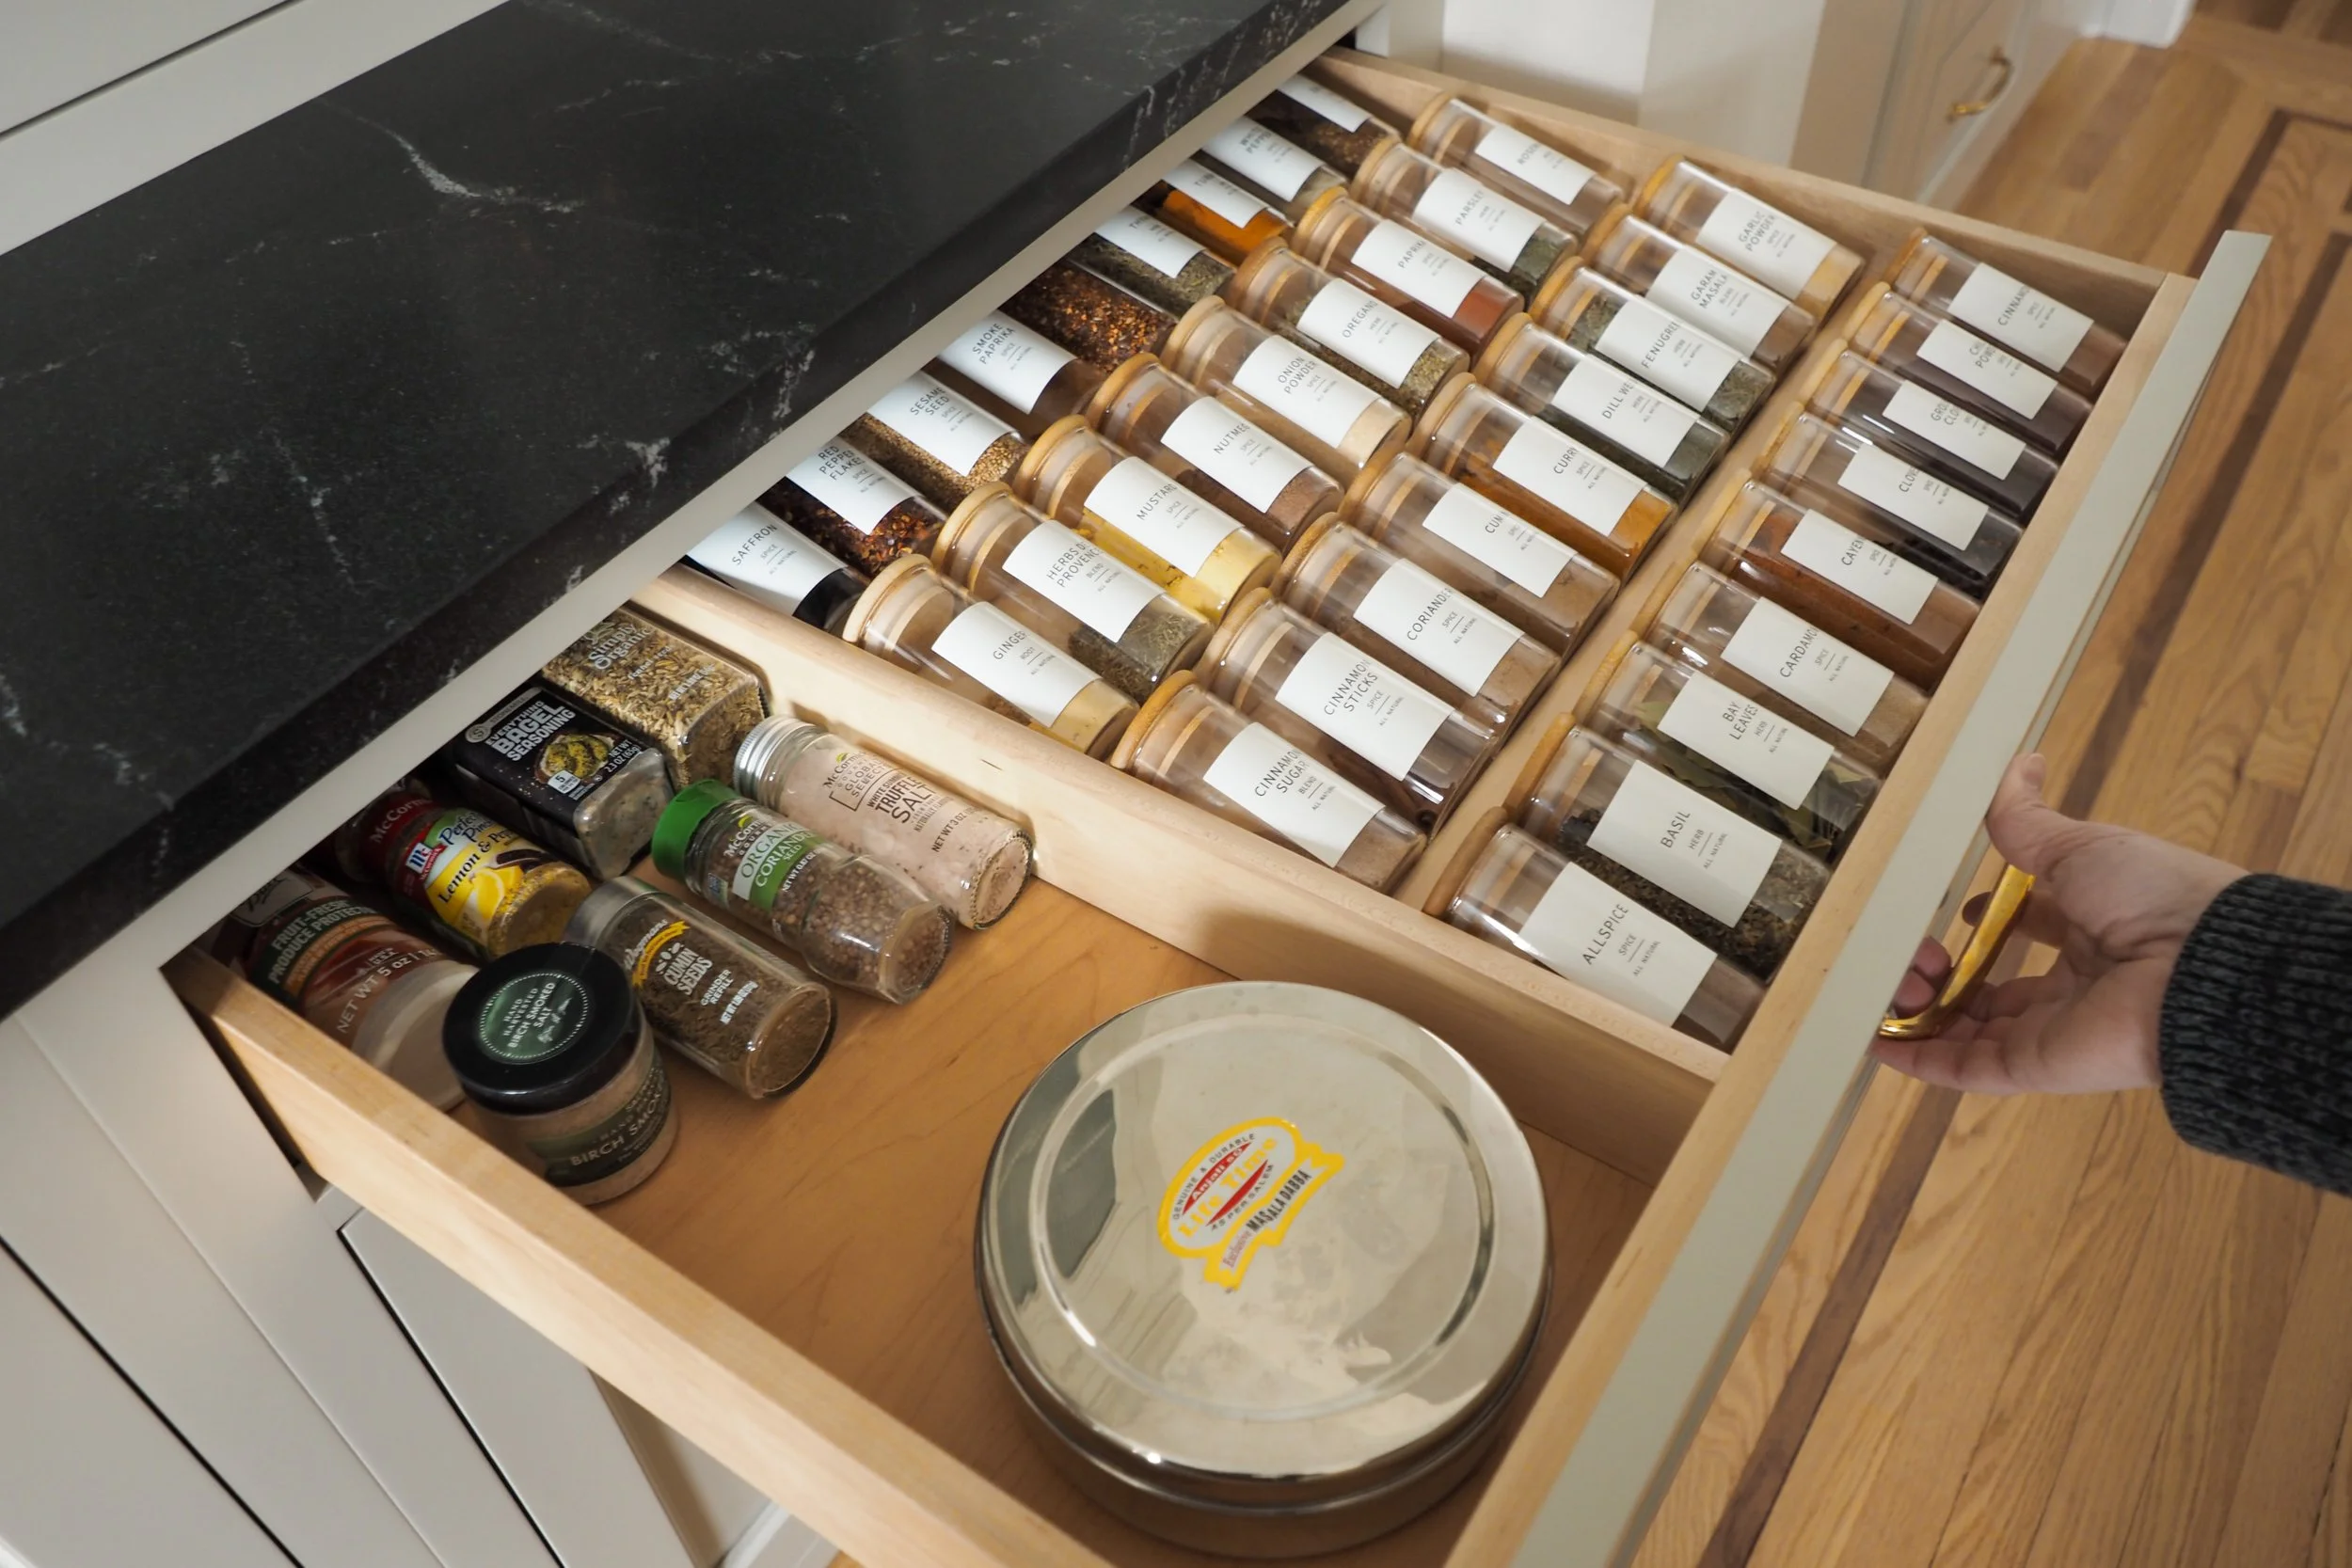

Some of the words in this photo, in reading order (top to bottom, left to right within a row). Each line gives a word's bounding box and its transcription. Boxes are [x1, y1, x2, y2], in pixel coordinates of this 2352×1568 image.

[1691, 269, 1719, 302] GARAM
[1698, 274, 1729, 309] MASALA
[972, 323, 1002, 356] SMOKE
[979, 326, 1015, 365] PAPRIKA
[1277, 356, 1306, 384] ONION
[1283, 361, 1316, 395] POWDER
[925, 395, 950, 417] SEED
[1601, 394, 1625, 420] DILL
[818, 445, 840, 462] RED
[1213, 422, 1250, 455] NUTMEG
[732, 522, 778, 567] SAFFRON
[758, 543, 779, 561] SPICE
[1046, 547, 1079, 581] HERBS
[1439, 610, 1459, 629] SPICE
[588, 623, 638, 661] Simply
[593, 627, 653, 671] Organic
[1813, 648, 1830, 667] SPICE
[1343, 671, 1379, 713] STICKS
[1366, 689, 1385, 709] SPICE
[485, 700, 546, 746] EVERYTHING
[1722, 699, 1741, 723] BAY
[1728, 704, 1758, 741] LEAVES
[491, 705, 566, 754] BAGEL
[506, 708, 577, 762] SEASONING
[1754, 721, 1770, 737] HERB
[603, 761, 618, 774] 2.3
[614, 752, 628, 767] OZ
[610, 743, 623, 760] NET
[619, 738, 633, 751] WT
[555, 774, 566, 784] 5
[1276, 760, 1311, 795] SUGAR
[1297, 775, 1318, 795] BLEND
[866, 786, 886, 809] WHITE
[874, 776, 924, 816] TRUFFLE
[890, 784, 939, 825] SALT
[930, 835, 946, 854] NET
[941, 823, 956, 838] WT
[949, 817, 960, 828] 3
[955, 811, 968, 825] OZ
[1660, 808, 1692, 849] BASIL
[1687, 829, 1705, 850] HERB
[783, 845, 803, 862] SEED
[437, 853, 482, 905] Lemon
[478, 840, 493, 855] &
[782, 878, 793, 893] NET
[787, 870, 800, 882] WT
[272, 898, 350, 952] FRUIT-FRESH
[1581, 902, 1630, 967] ALLSPICE
[267, 926, 317, 985] PRODUCE
[1617, 932, 1638, 958] SPICE
[663, 947, 700, 986] CUMIN
[676, 957, 714, 996] SEEDS
[336, 1000, 361, 1036] NET
[356, 974, 380, 1001] WT
[376, 965, 392, 978] 5
[389, 956, 412, 970] oz
[700, 969, 733, 1006] GRINDER
[710, 977, 735, 1006] REFILL
[502, 988, 539, 1037] HARVESTED
[503, 998, 524, 1022] HAND
[507, 1022, 532, 1049] BIRCH
[526, 982, 557, 1021] SMOKED
[532, 1006, 553, 1028] SALT
[569, 1135, 627, 1167] BIRCH
[1219, 1136, 1279, 1191] Time
[1173, 1177, 1199, 1221] GENUINE
[1208, 1132, 1256, 1164] DURABLE
[1210, 1219, 1227, 1232] AS
[1227, 1199, 1249, 1221] PER
[1248, 1164, 1275, 1200] SALEM
[1245, 1196, 1288, 1234] MASALA
[1283, 1168, 1313, 1203] DABBA
